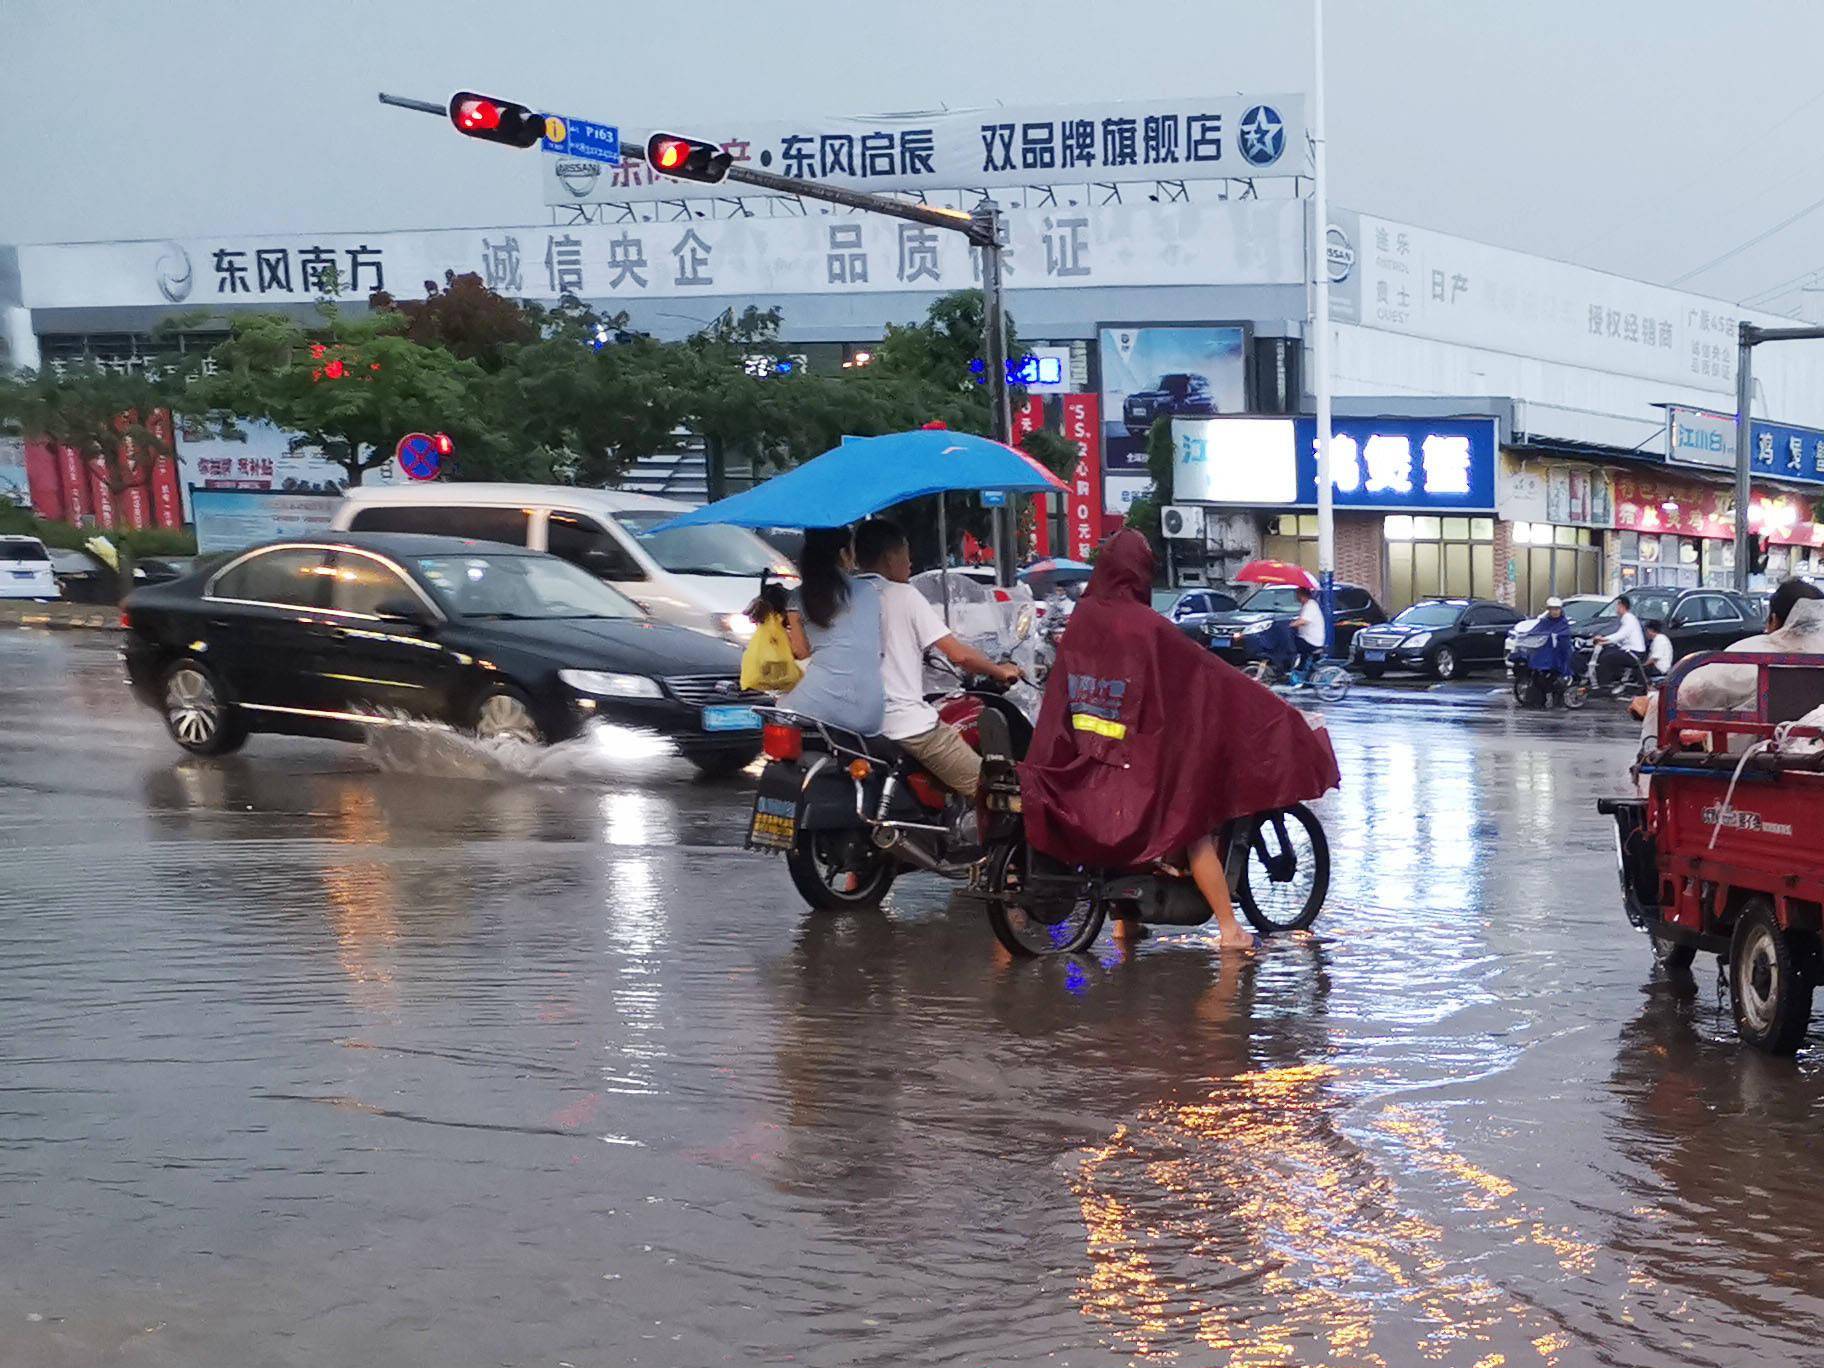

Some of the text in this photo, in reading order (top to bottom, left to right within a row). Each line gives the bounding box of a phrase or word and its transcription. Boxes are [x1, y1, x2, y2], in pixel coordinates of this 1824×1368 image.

[585, 126, 614, 144] P163
[980, 112, 1223, 172] 双品牌旗舰店
[213, 243, 385, 293] 东风南方
[482, 227, 714, 294] 诚信央企
[1431, 269, 1468, 305] 日产
[1588, 303, 1674, 350] 授权经销商
